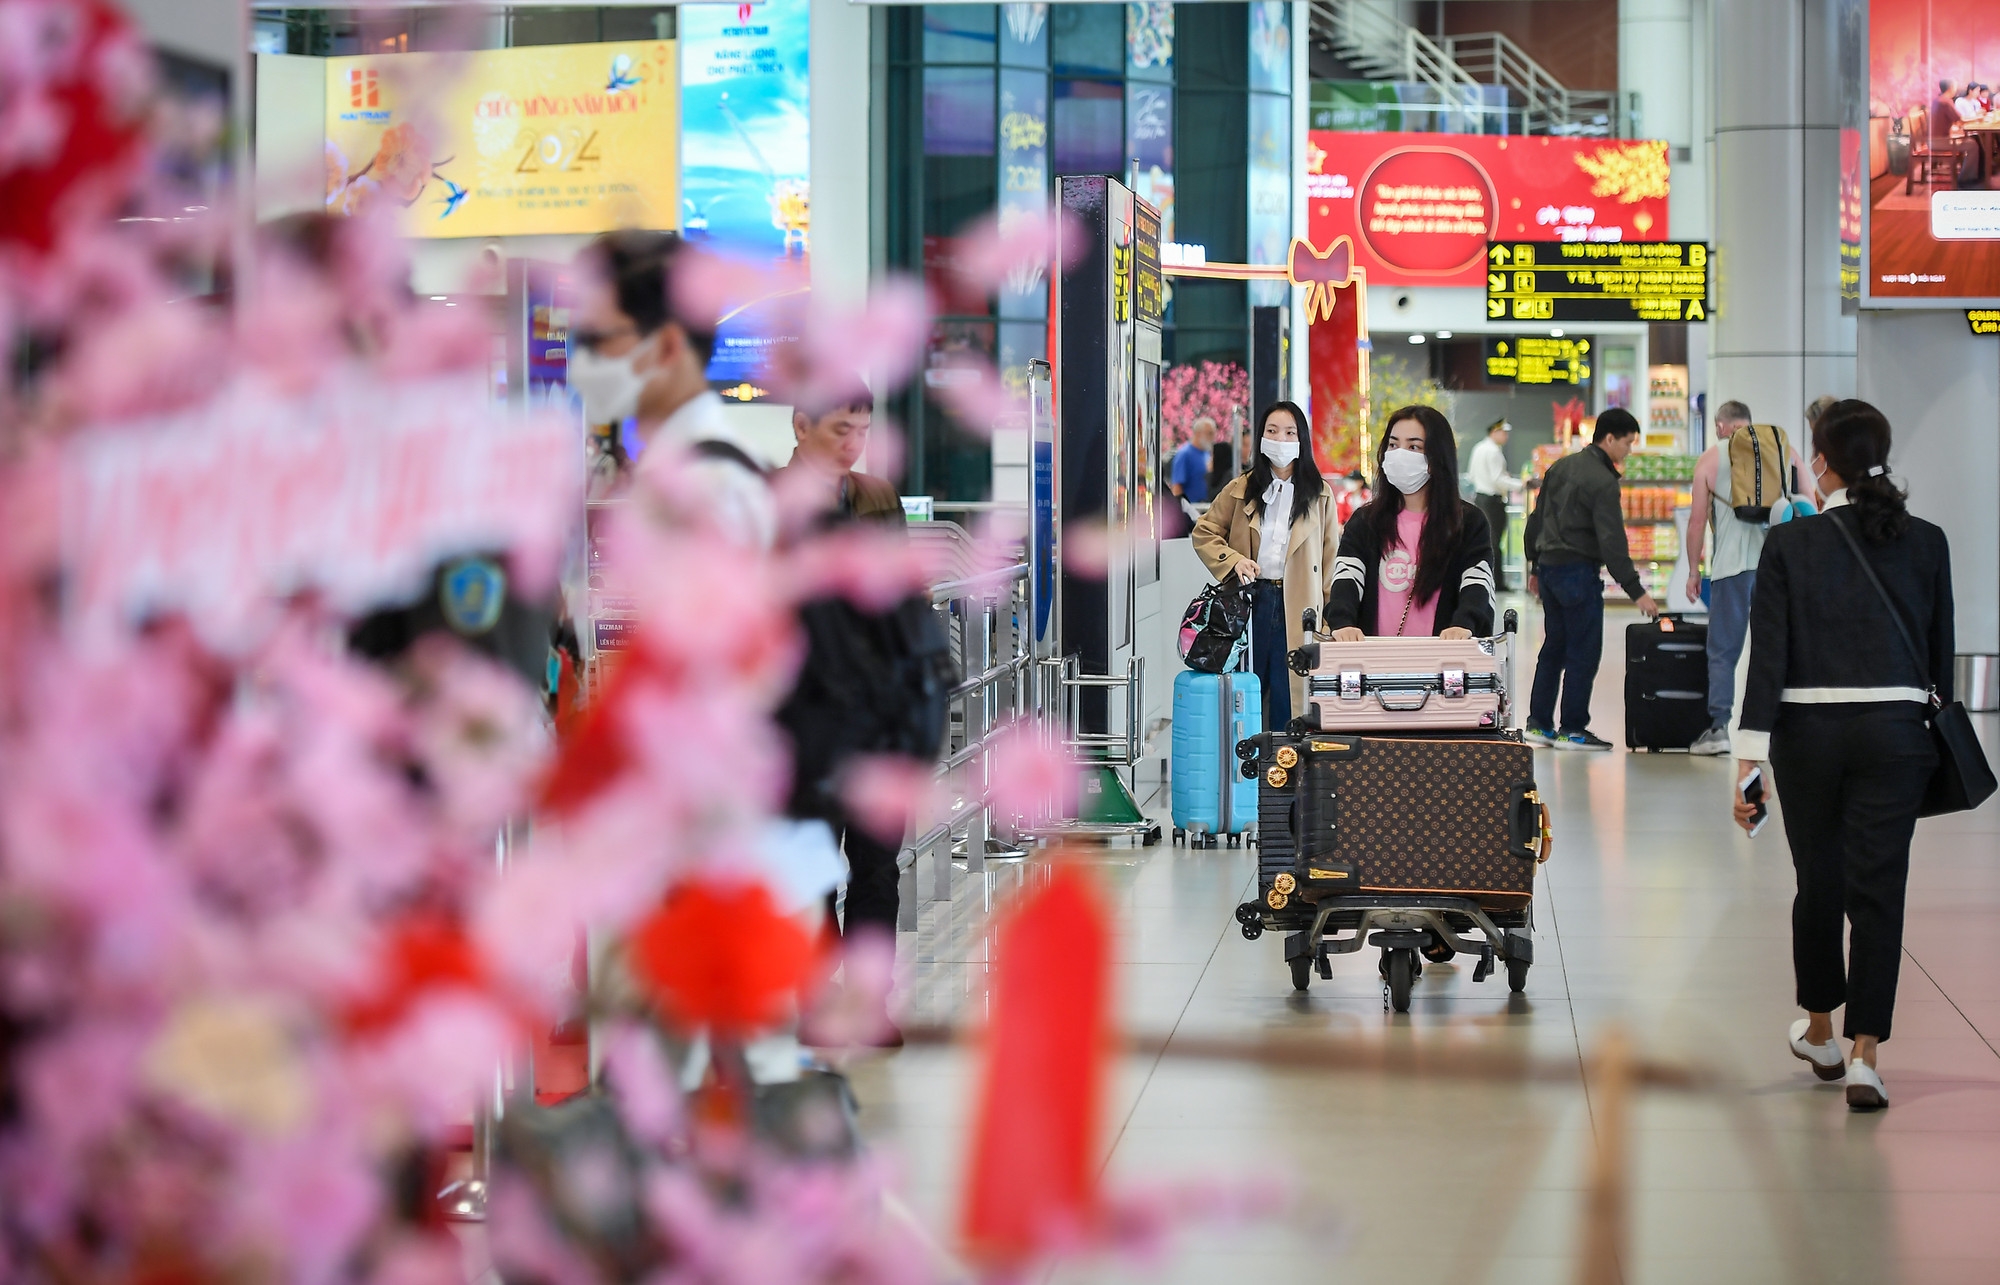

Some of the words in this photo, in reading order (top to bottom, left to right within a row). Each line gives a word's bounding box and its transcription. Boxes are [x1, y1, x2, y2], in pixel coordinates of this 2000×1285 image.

[514, 125, 601, 174] 2024
[1689, 244, 1707, 267] B
[1567, 271, 1577, 284] Y
[1685, 299, 1705, 320] A
